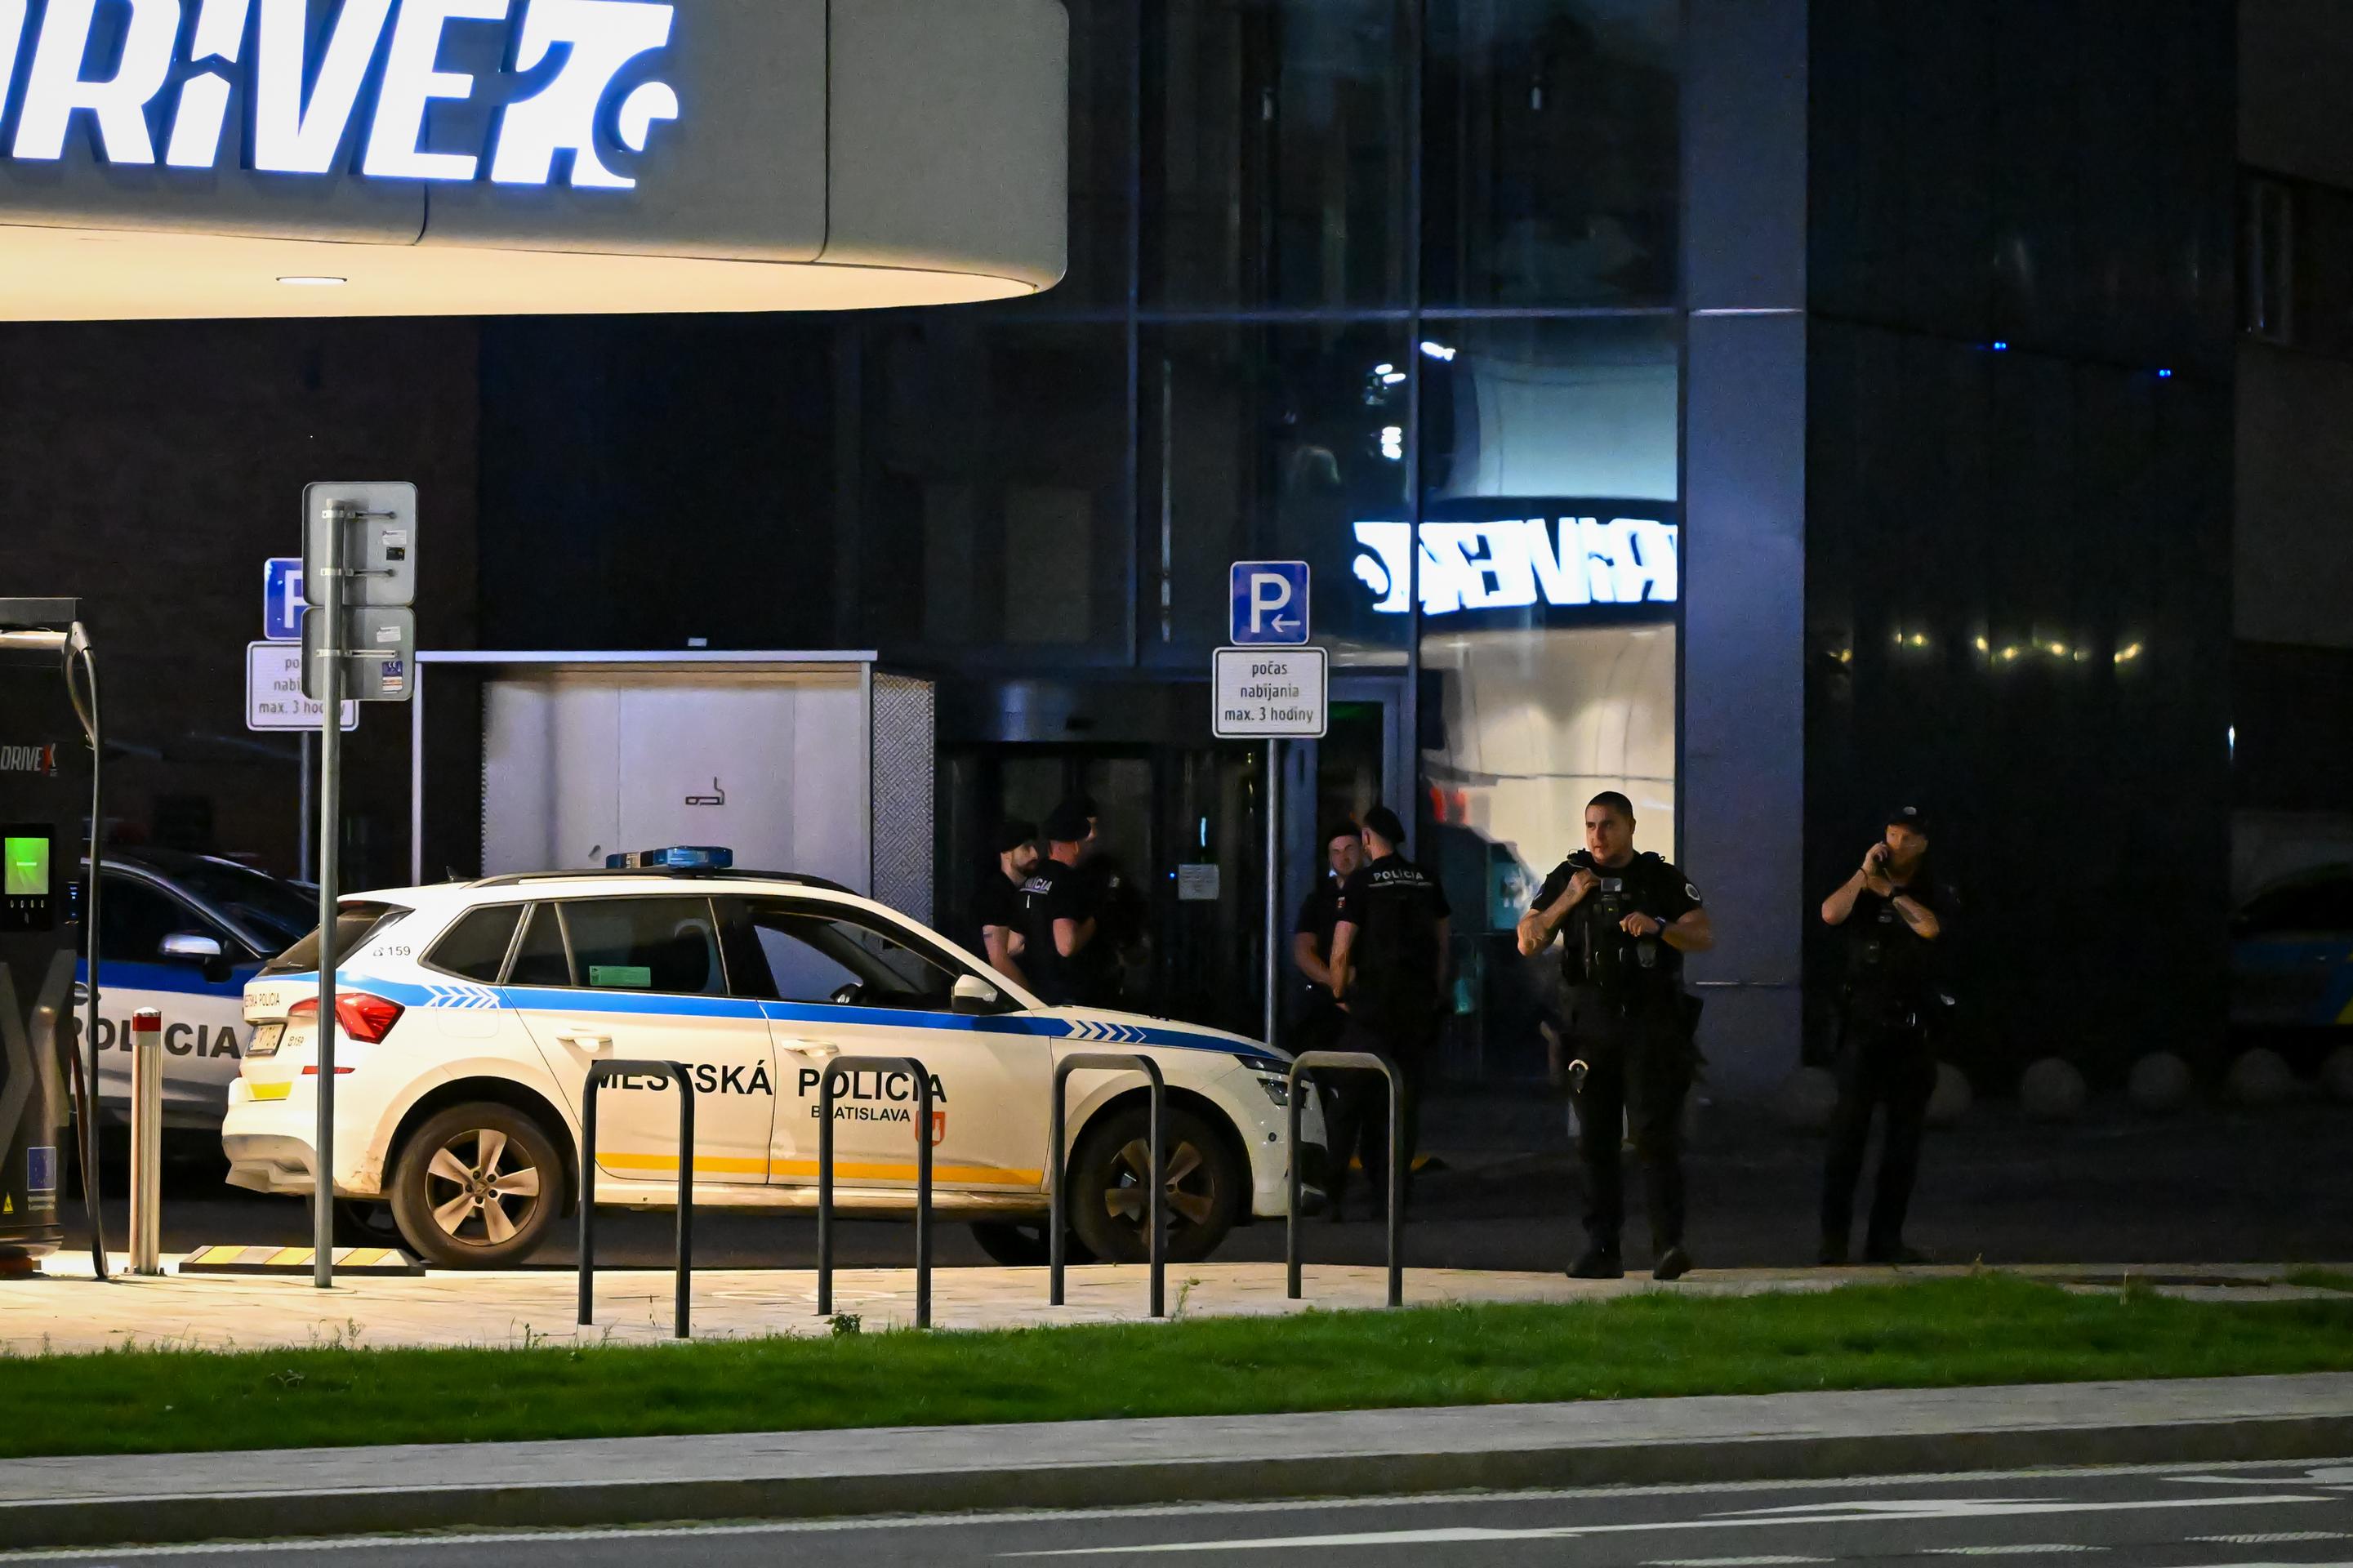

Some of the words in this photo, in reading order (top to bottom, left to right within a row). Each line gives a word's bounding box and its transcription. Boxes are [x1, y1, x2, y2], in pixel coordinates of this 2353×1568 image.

[1250, 572, 1291, 634] P
[1252, 661, 1287, 678] počas
[259, 702, 287, 714] max.
[292, 700, 300, 714] 3
[1224, 709, 1254, 721] max.
[1259, 706, 1267, 721] 3
[1271, 706, 1313, 724] hodiny
[388, 946, 411, 956] 159
[73, 1016, 242, 1059] OLCIA
[592, 1059, 773, 1096] ESSKÁ
[811, 1105, 911, 1123] BATISLAVA
